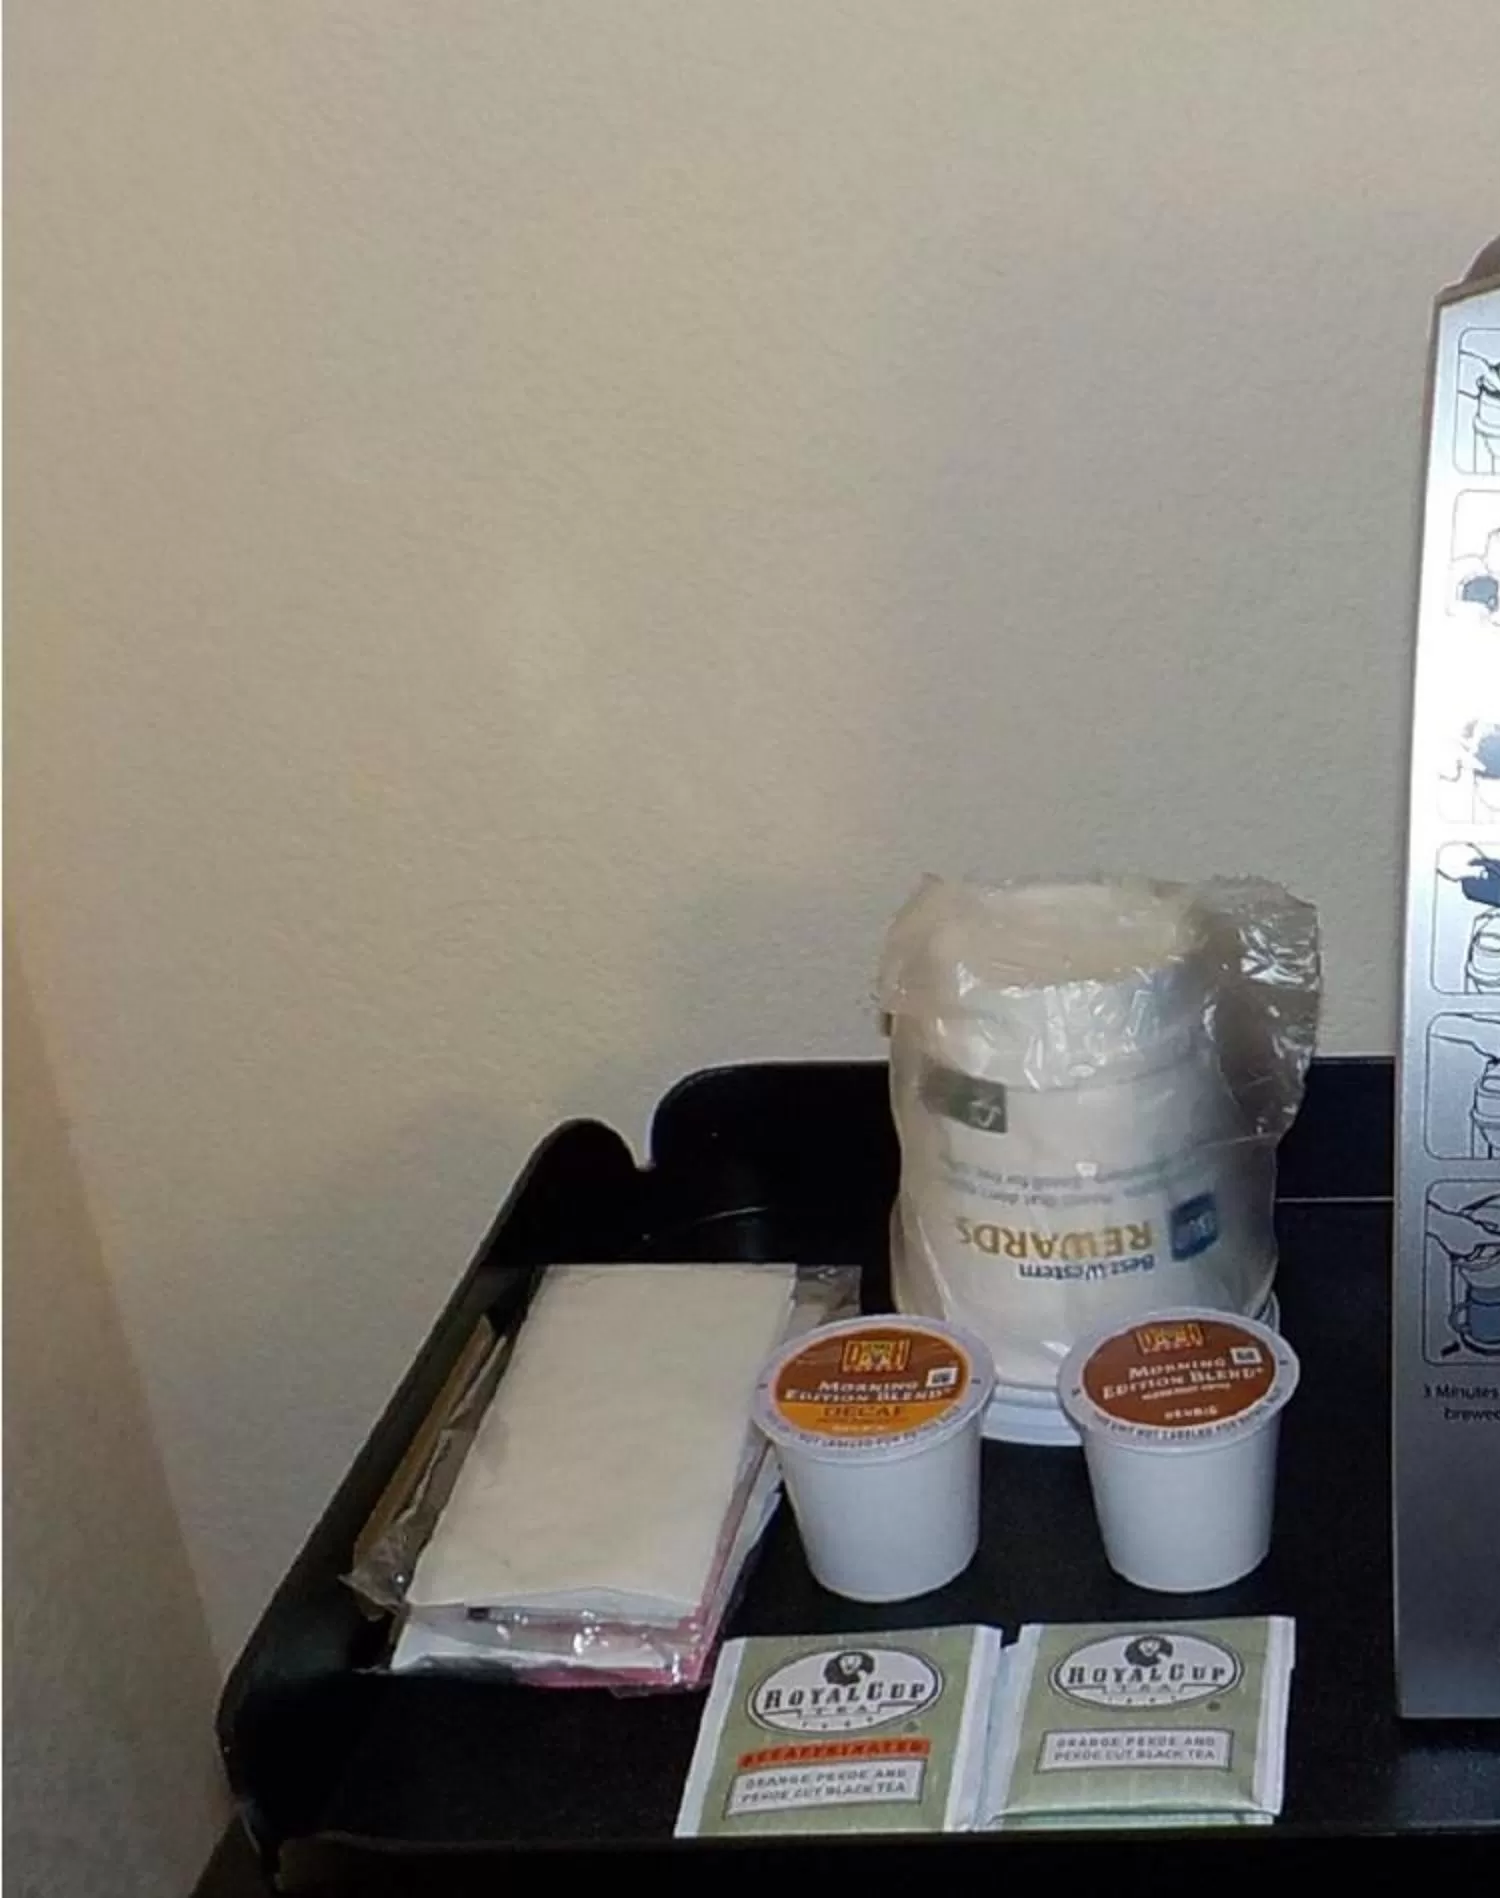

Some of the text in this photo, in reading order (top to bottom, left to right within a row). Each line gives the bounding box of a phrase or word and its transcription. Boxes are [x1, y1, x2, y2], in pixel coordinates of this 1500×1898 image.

[955, 1217, 1154, 1260] REWARDS
[1018, 1253, 1155, 1281] Best Western
[1128, 1357, 1227, 1380] MORNING
[1103, 1375, 1184, 1400] EDITION
[1436, 1384, 1499, 1399] Minutes
[1056, 1735, 1216, 1747] ORANGE PEKOE AND
[1104, 1750, 1132, 1761] CUT
[1135, 1750, 1184, 1760] BLACK
[1187, 1749, 1217, 1759] TEA
[745, 1769, 907, 1788] ORANGE PEKOE AND
[793, 1787, 822, 1799] CUT
[824, 1784, 873, 1796] BLACK
[876, 1782, 907, 1794] TEA
